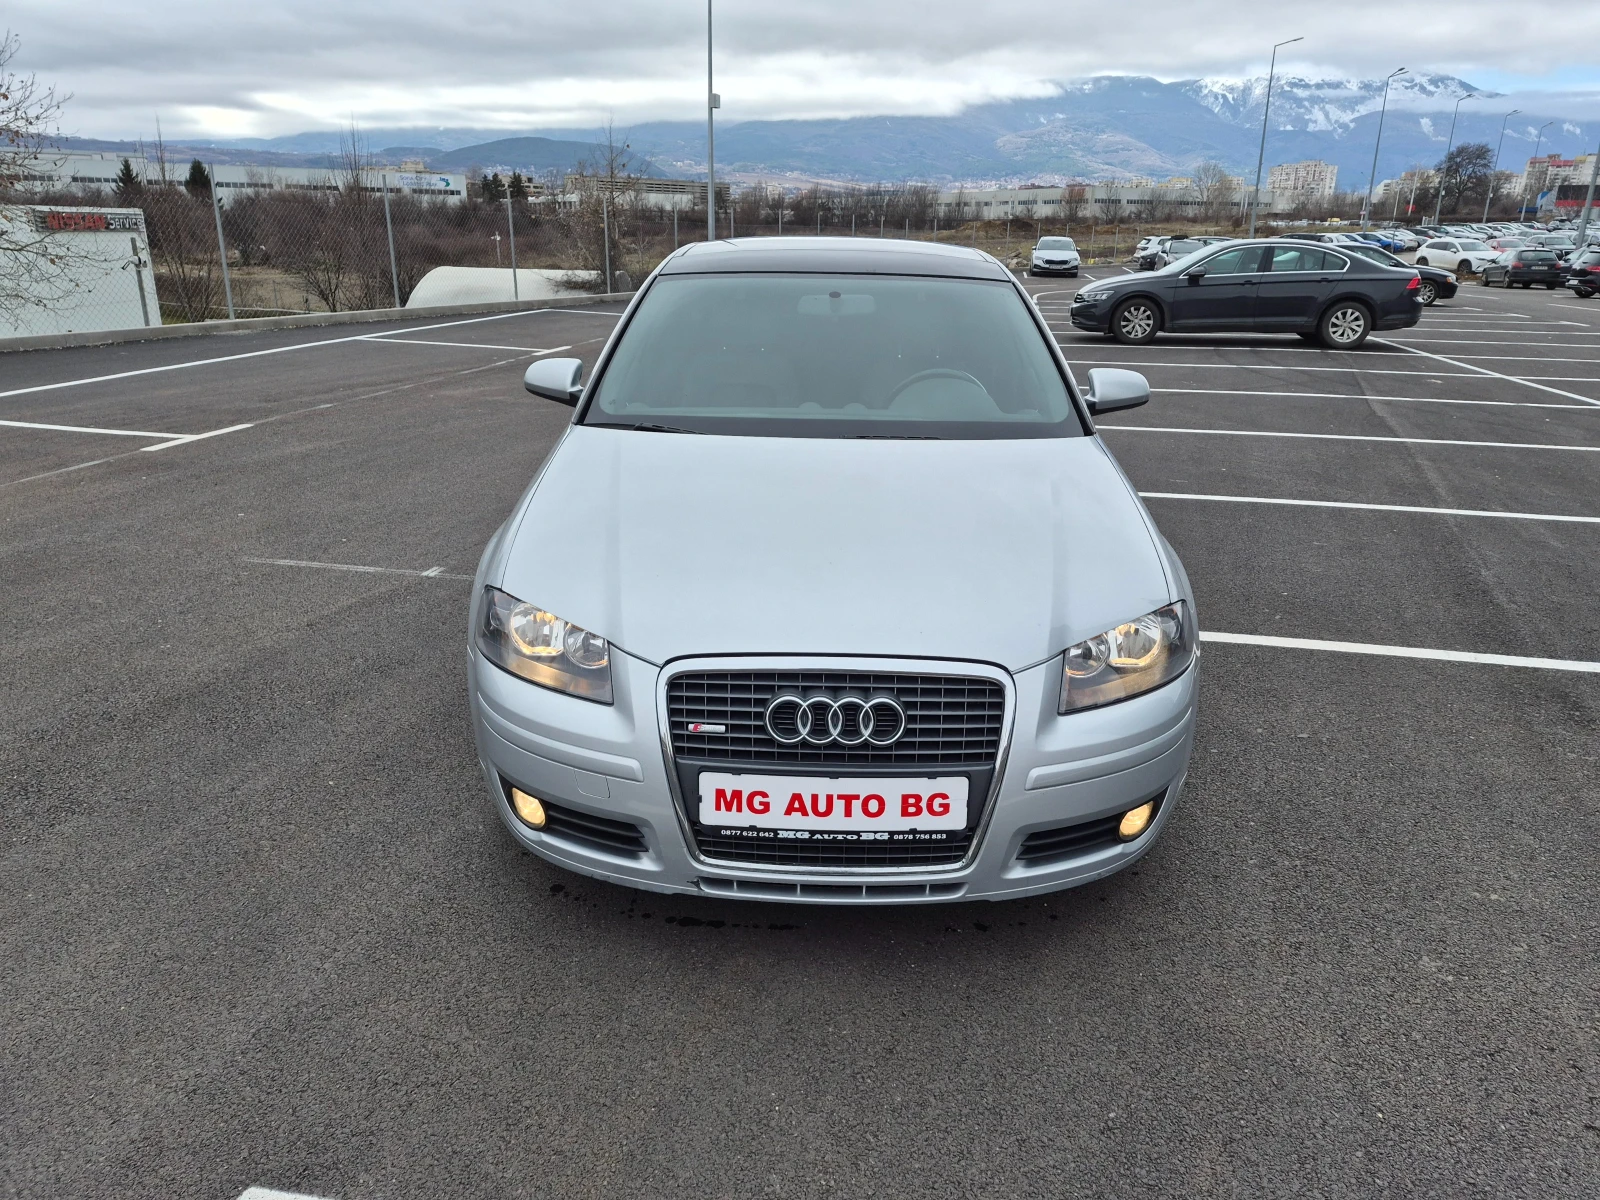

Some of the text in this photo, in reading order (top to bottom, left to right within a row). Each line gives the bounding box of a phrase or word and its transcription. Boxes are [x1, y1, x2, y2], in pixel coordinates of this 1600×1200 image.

[47, 211, 144, 230] NISSAN Service
[714, 788, 951, 818] MG AUTO BG
[777, 830, 811, 839] MG
[860, 832, 890, 840] BG
